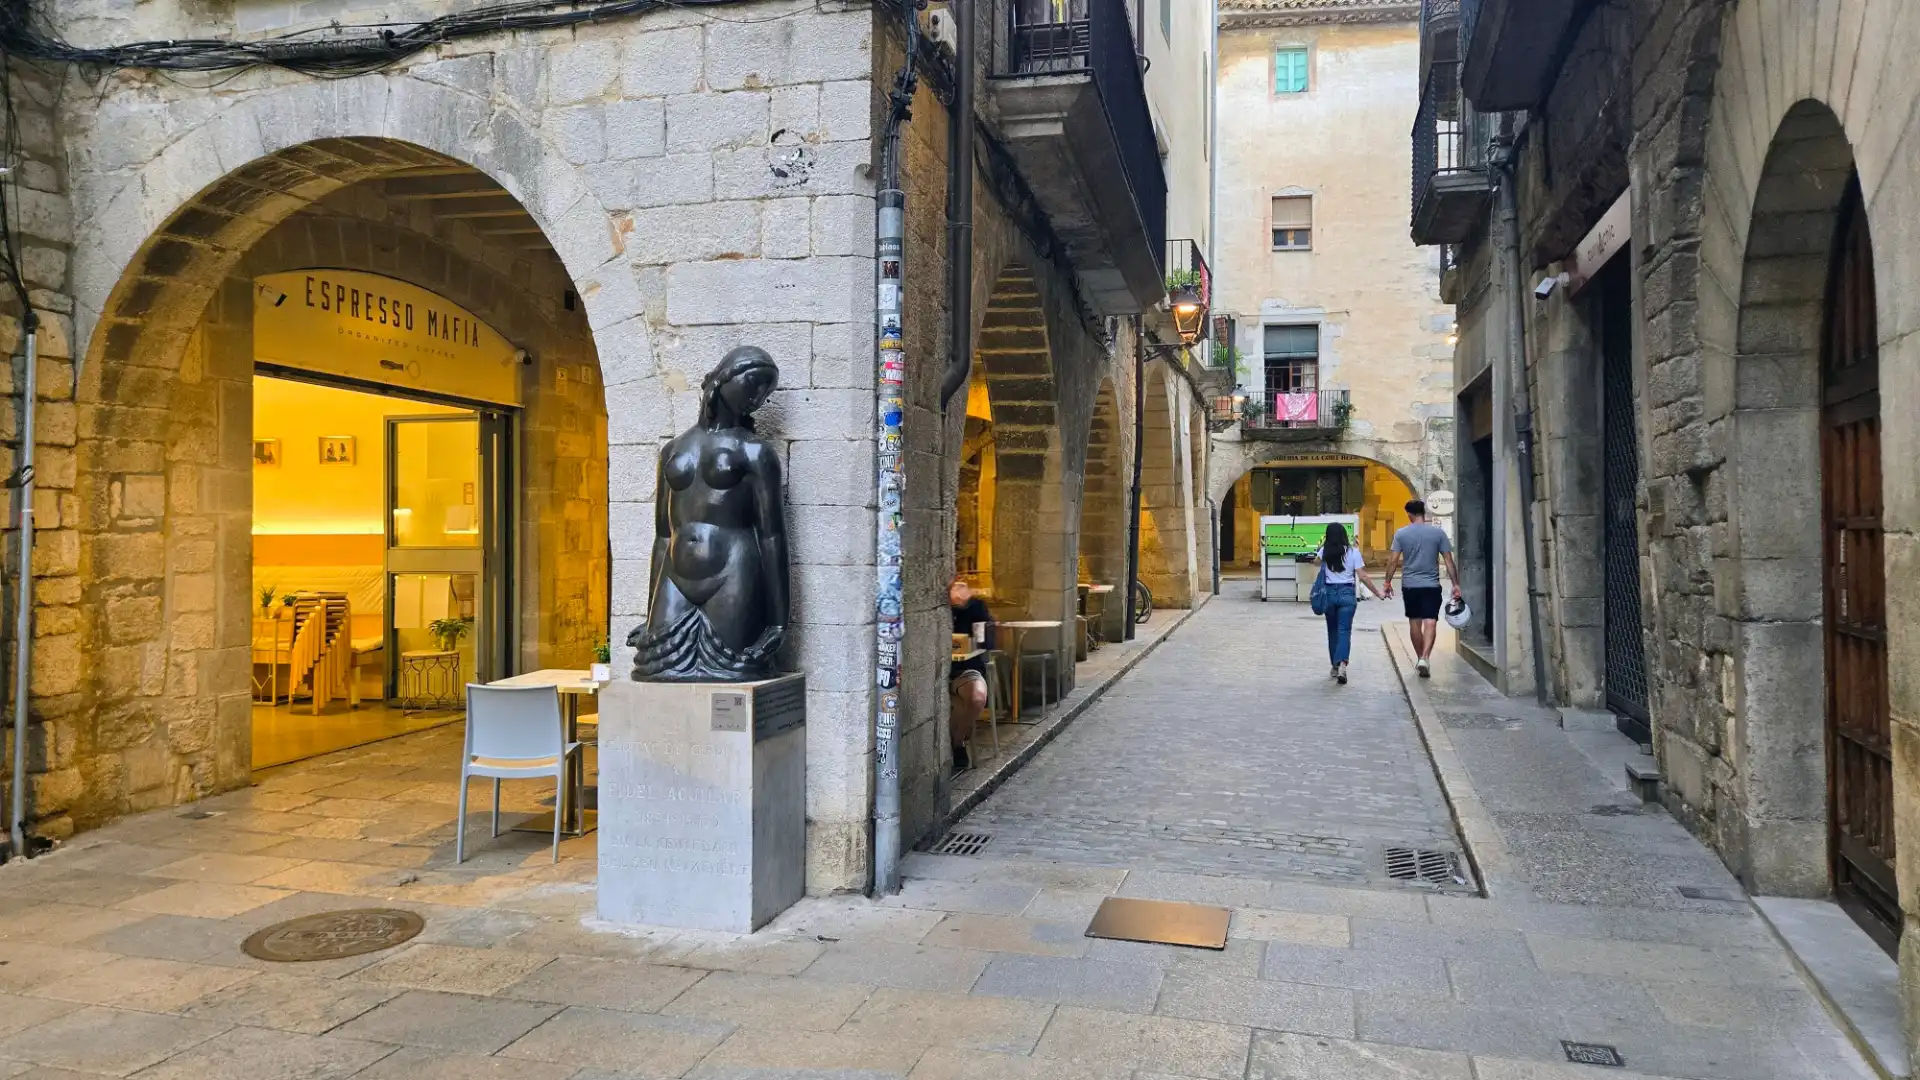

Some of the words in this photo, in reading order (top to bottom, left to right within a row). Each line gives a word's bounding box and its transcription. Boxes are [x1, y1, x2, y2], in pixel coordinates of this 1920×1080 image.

[306, 276, 413, 331] ESPRESSO
[428, 309, 479, 348] MAFIA
[607, 780, 660, 801] FIDEL
[665, 784, 742, 805] AGUILAR
[599, 852, 628, 869] DEL
